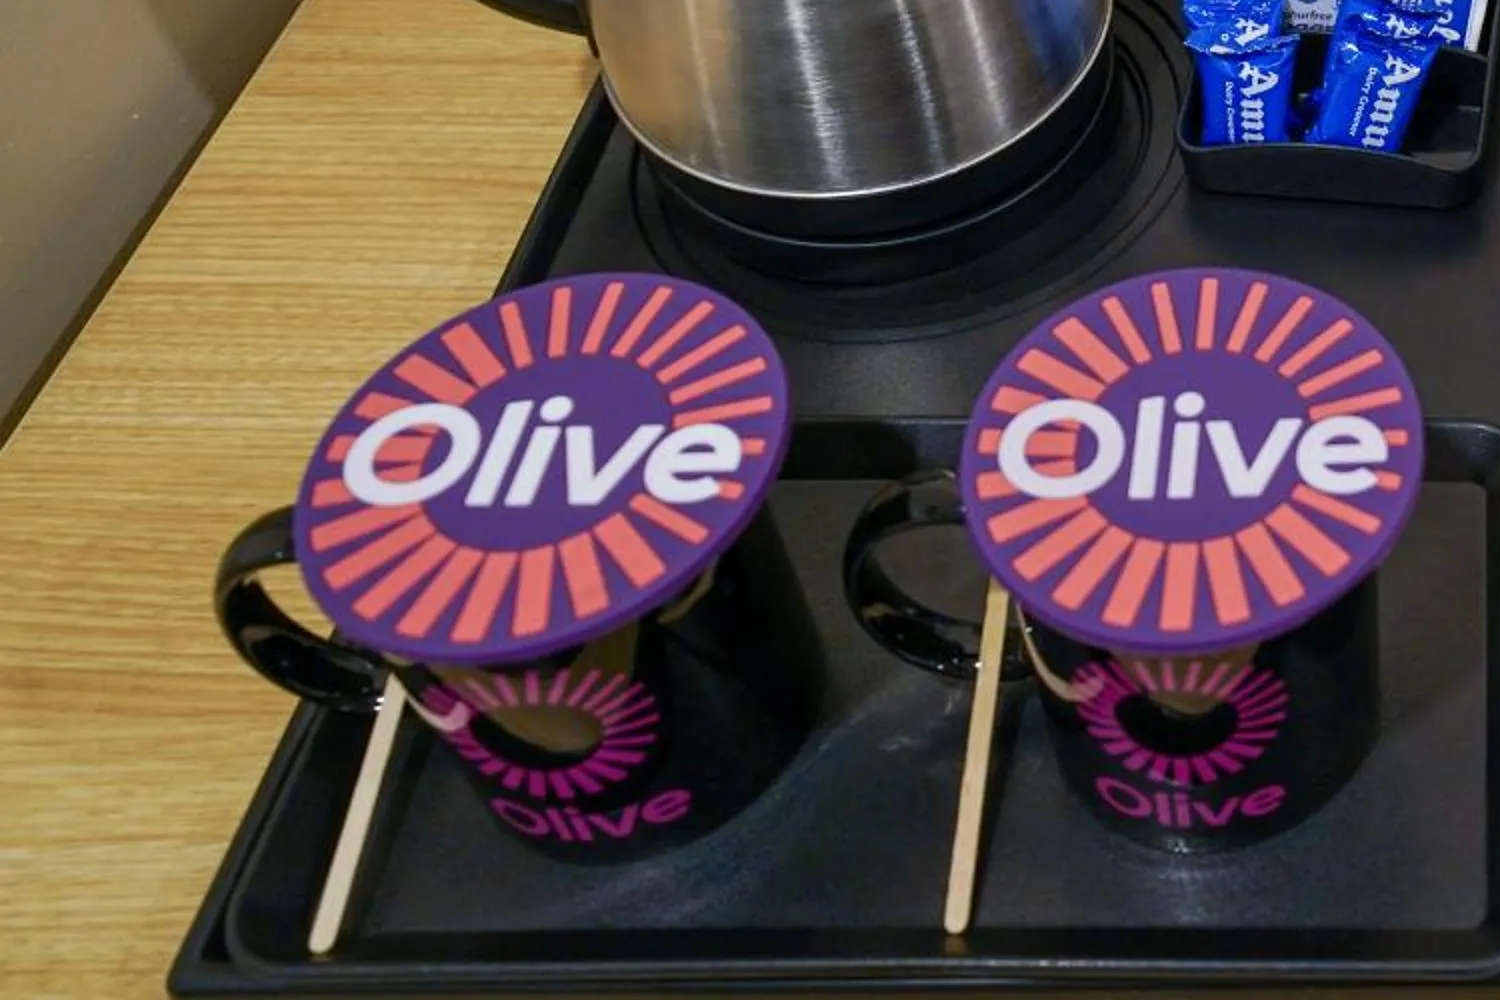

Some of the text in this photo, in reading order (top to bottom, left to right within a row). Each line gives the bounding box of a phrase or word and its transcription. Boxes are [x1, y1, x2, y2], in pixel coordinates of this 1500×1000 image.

[1237, 61, 1279, 142] Am
[1361, 53, 1421, 147] Amu
[342, 396, 743, 508] Olive
[998, 391, 1388, 500] Olive
[489, 788, 692, 842] Olive
[1095, 776, 1286, 828] Olive
